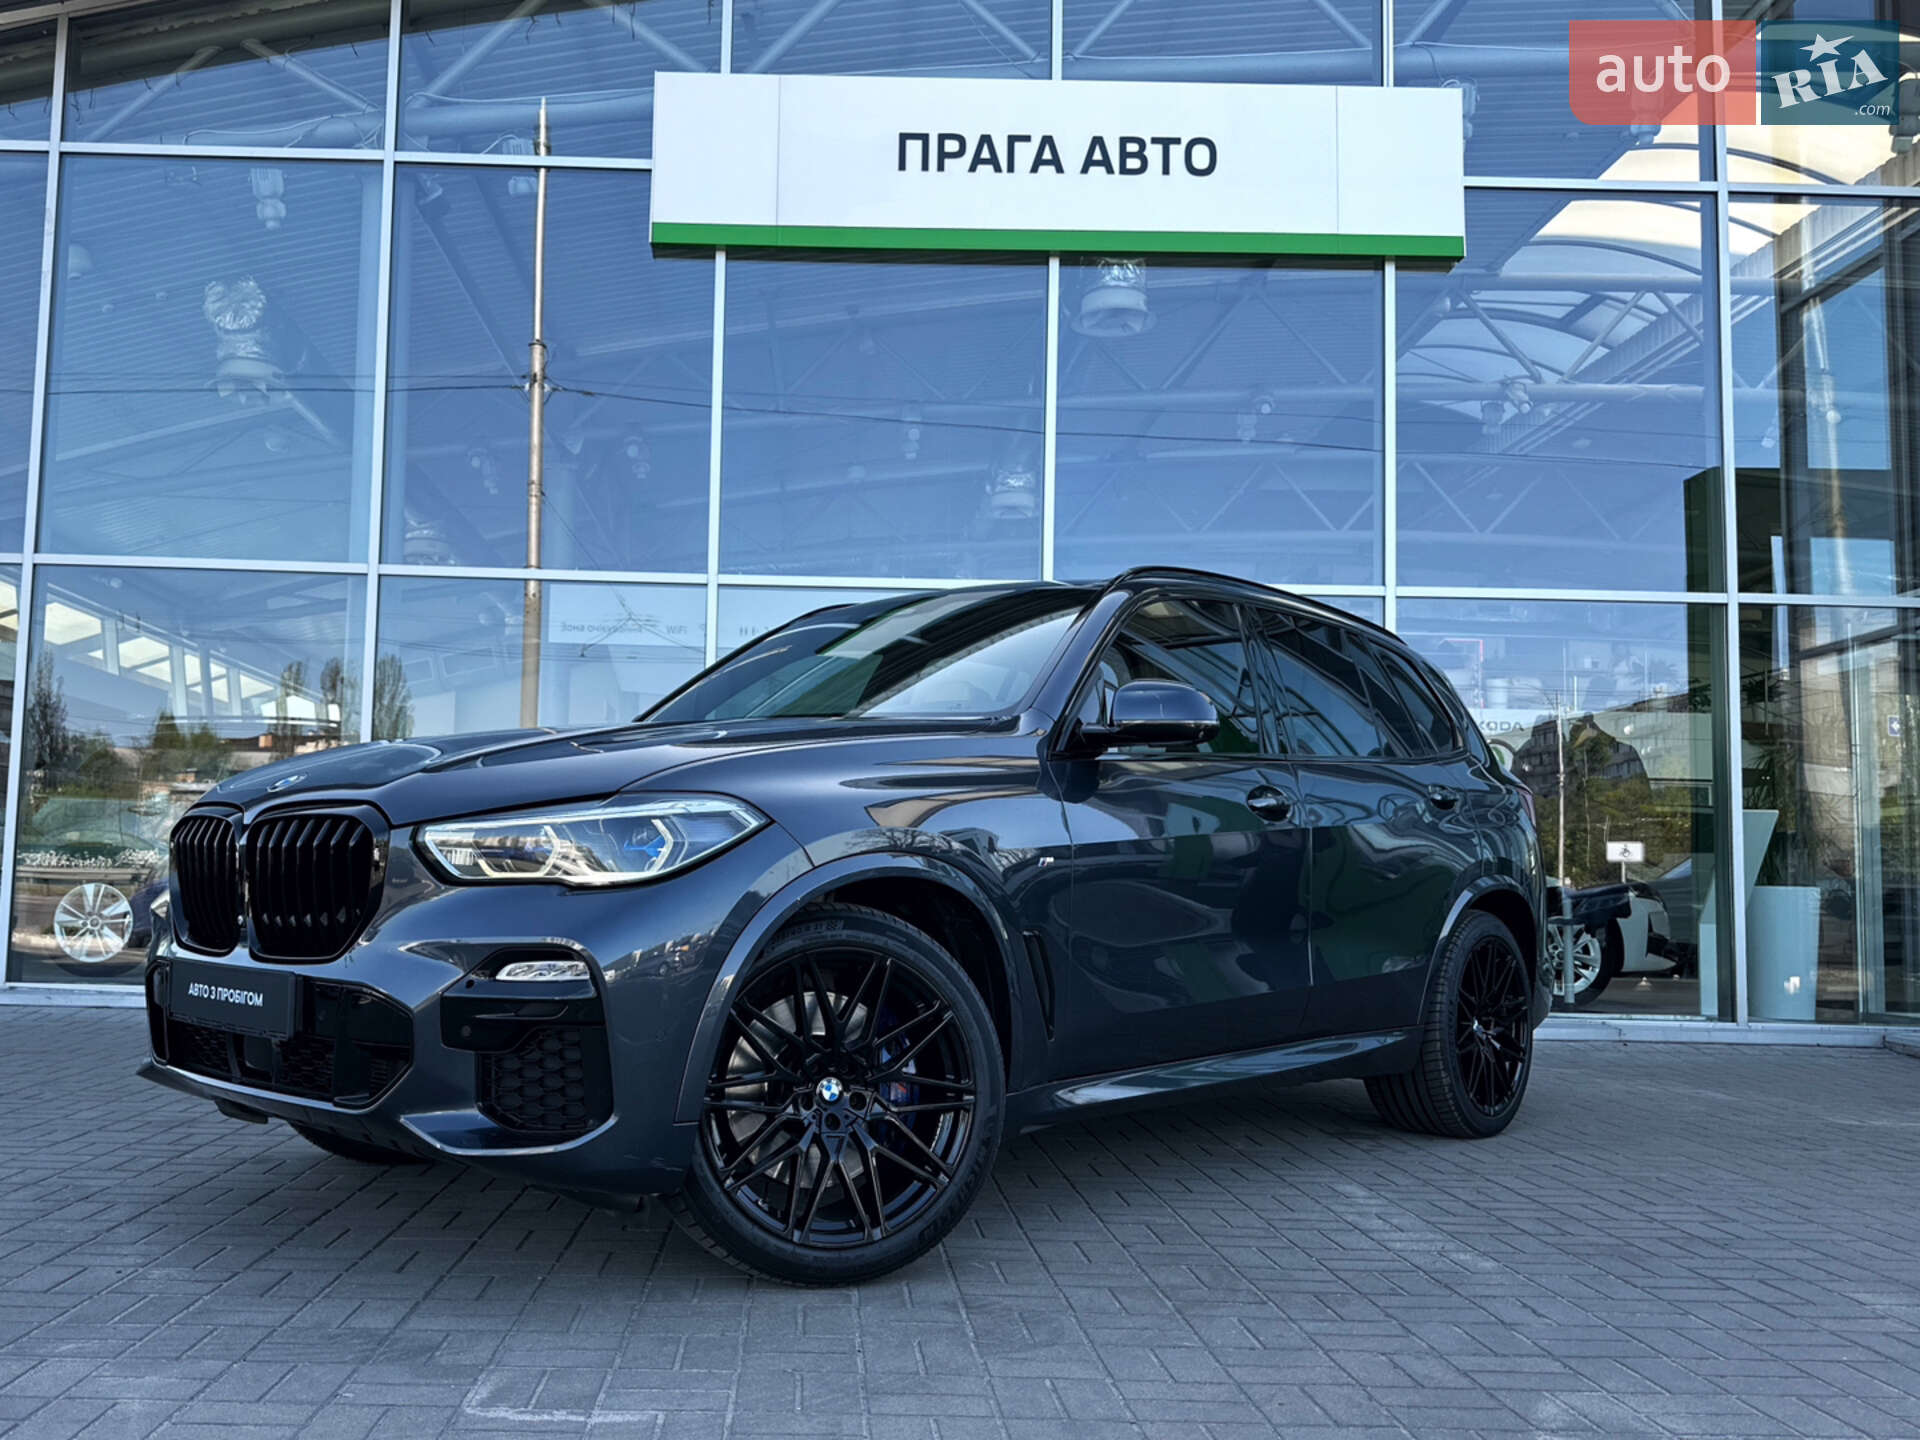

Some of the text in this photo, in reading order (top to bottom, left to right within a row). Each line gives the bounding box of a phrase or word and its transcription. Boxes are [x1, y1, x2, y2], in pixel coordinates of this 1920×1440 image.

[898, 132, 1218, 177] ПРАГА АВТО
[188, 982, 209, 998] АВТО
[217, 987, 264, 1007] ПРОБІГОМ
